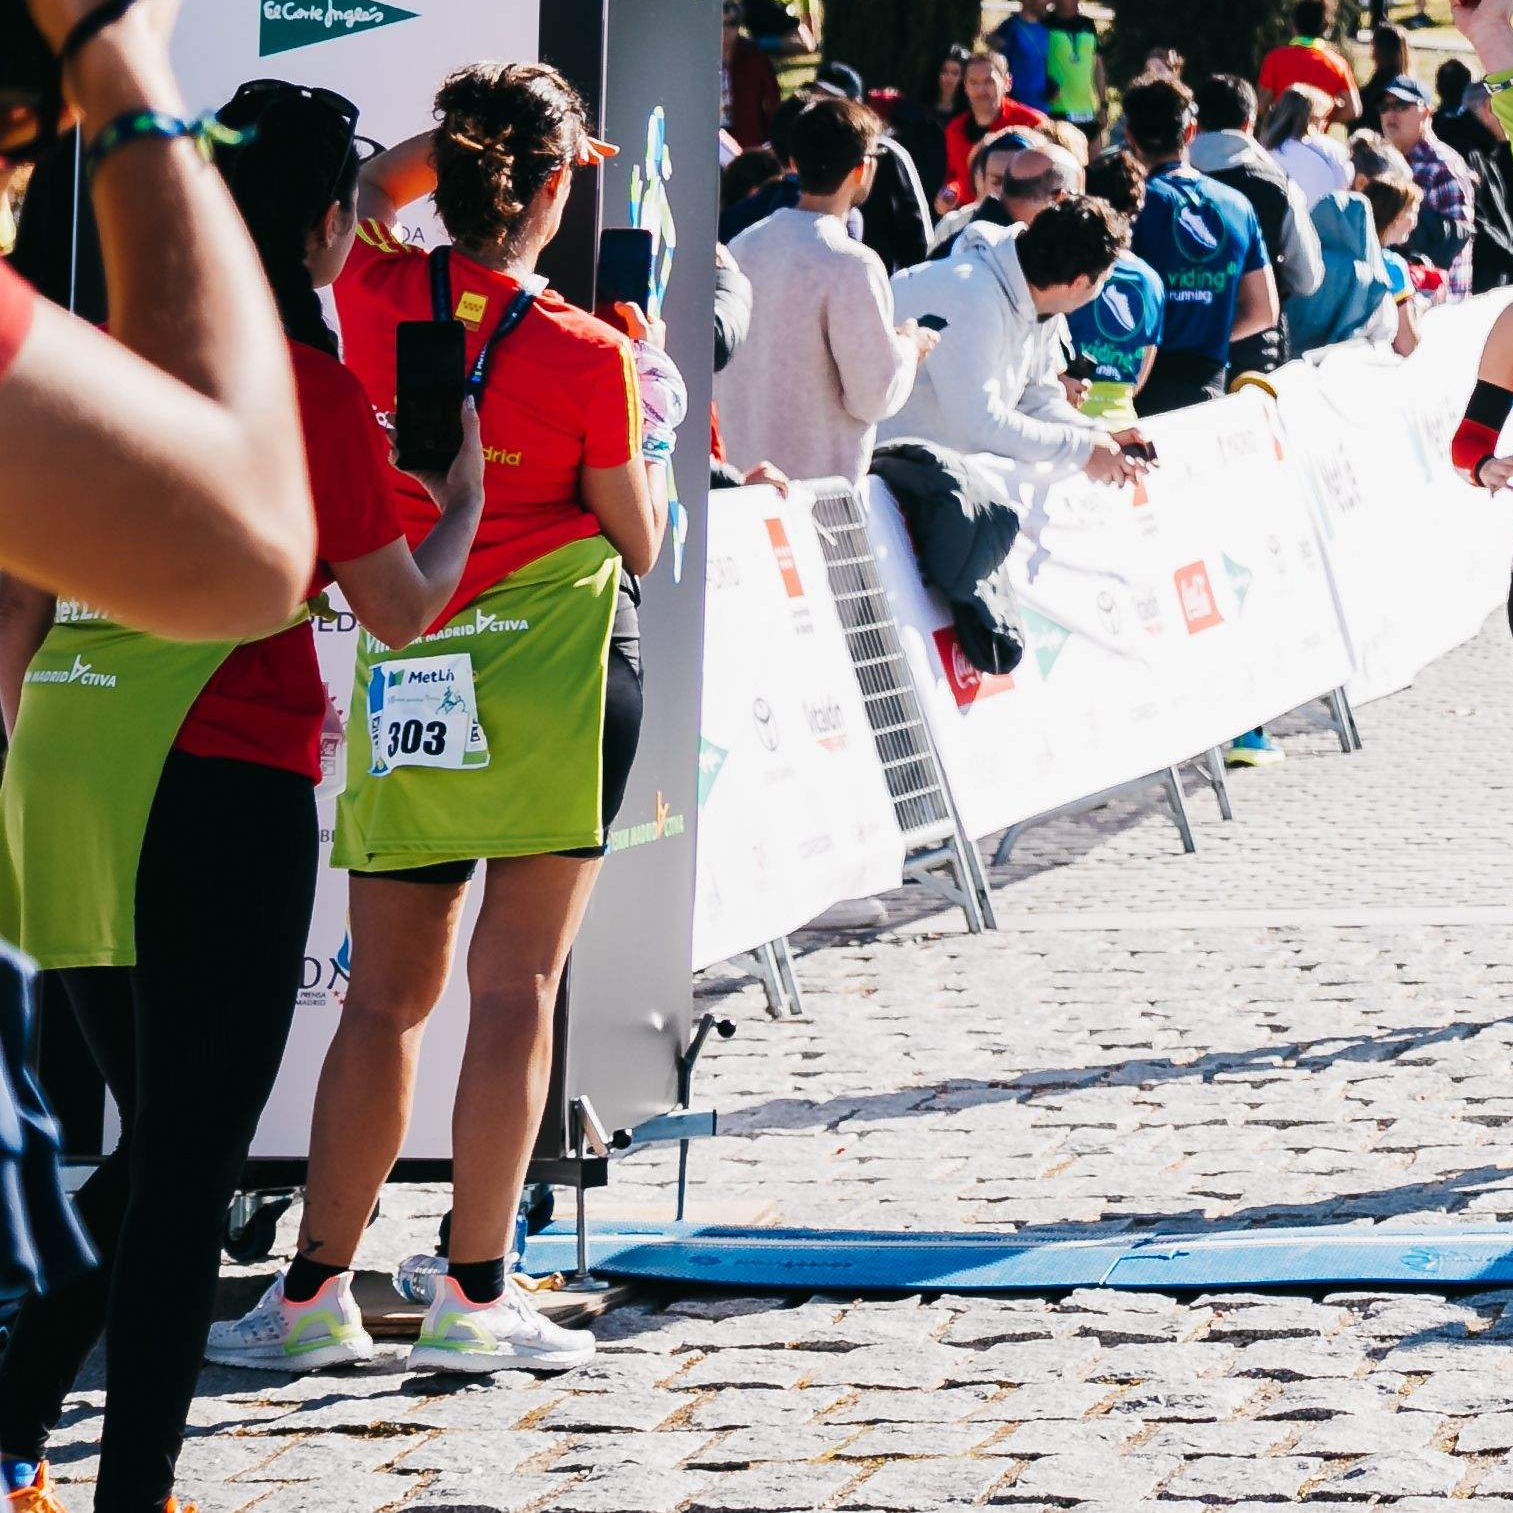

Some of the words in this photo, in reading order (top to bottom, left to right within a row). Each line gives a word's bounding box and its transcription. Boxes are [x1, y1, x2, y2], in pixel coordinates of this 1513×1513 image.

[264, 3, 283, 19] El
[282, 3, 324, 24] Corte
[324, 0, 385, 29] Inglés
[1169, 290, 1212, 304] running
[482, 446, 522, 466] drid
[387, 719, 447, 758] 303
